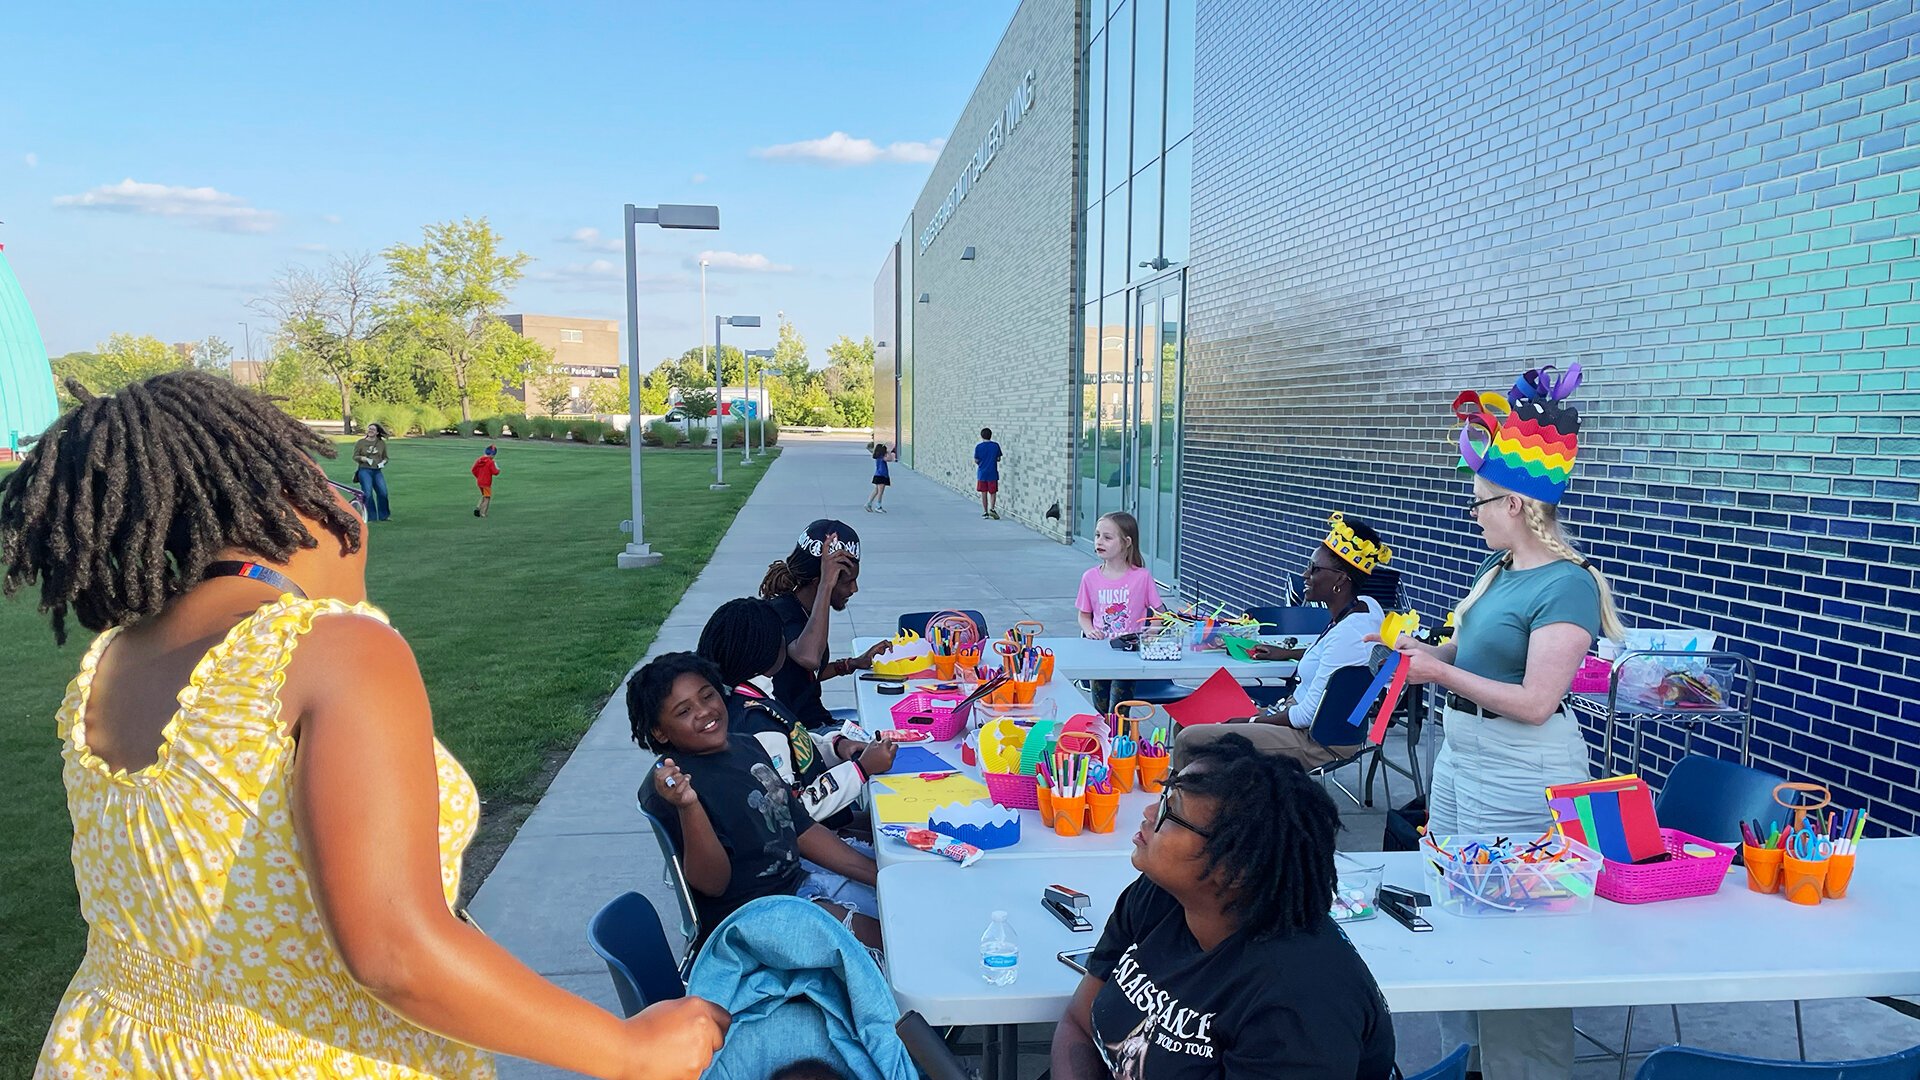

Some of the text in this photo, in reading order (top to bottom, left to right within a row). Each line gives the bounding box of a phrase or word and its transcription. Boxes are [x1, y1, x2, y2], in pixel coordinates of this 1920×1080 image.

[973, 110, 1006, 183] GALLERY
[1005, 68, 1036, 136] WING
[571, 367, 595, 377] Parking
[1098, 588, 1130, 605] MUSIC
[1112, 942, 1217, 1043] NAISSANCE
[1184, 1042, 1214, 1059] TOUR
